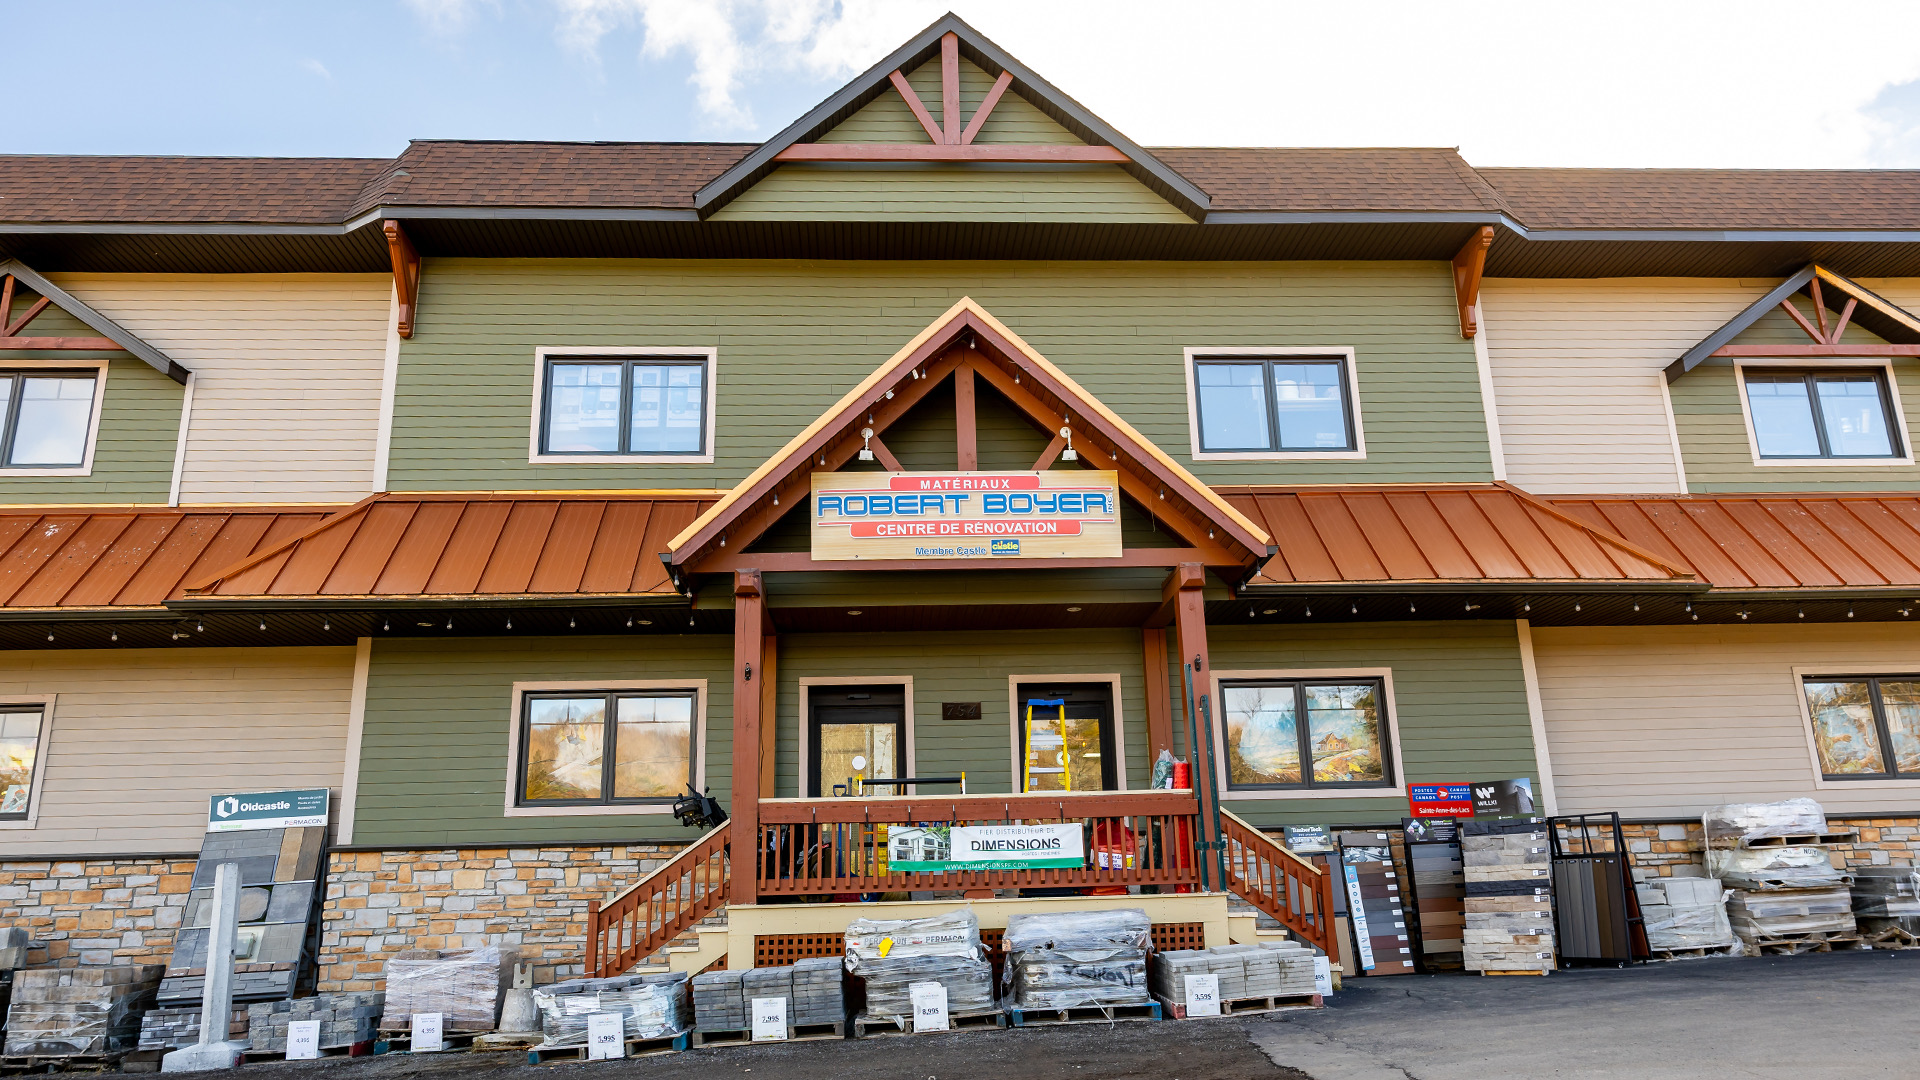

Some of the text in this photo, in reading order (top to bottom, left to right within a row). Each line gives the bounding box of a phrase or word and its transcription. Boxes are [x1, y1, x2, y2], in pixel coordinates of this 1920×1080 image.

[920, 477, 1010, 490] MATÉRIAUX
[817, 494, 970, 517] ROBERT
[983, 492, 1108, 515] BOYER
[876, 520, 1057, 536] CENTRE DE RÉNOVATION
[915, 546, 987, 556] Membre Castle
[946, 704, 977, 717] 754
[240, 800, 291, 812] Oldcastle
[971, 838, 1061, 851] DIMENSIONS
[864, 936, 906, 945] PERCON
